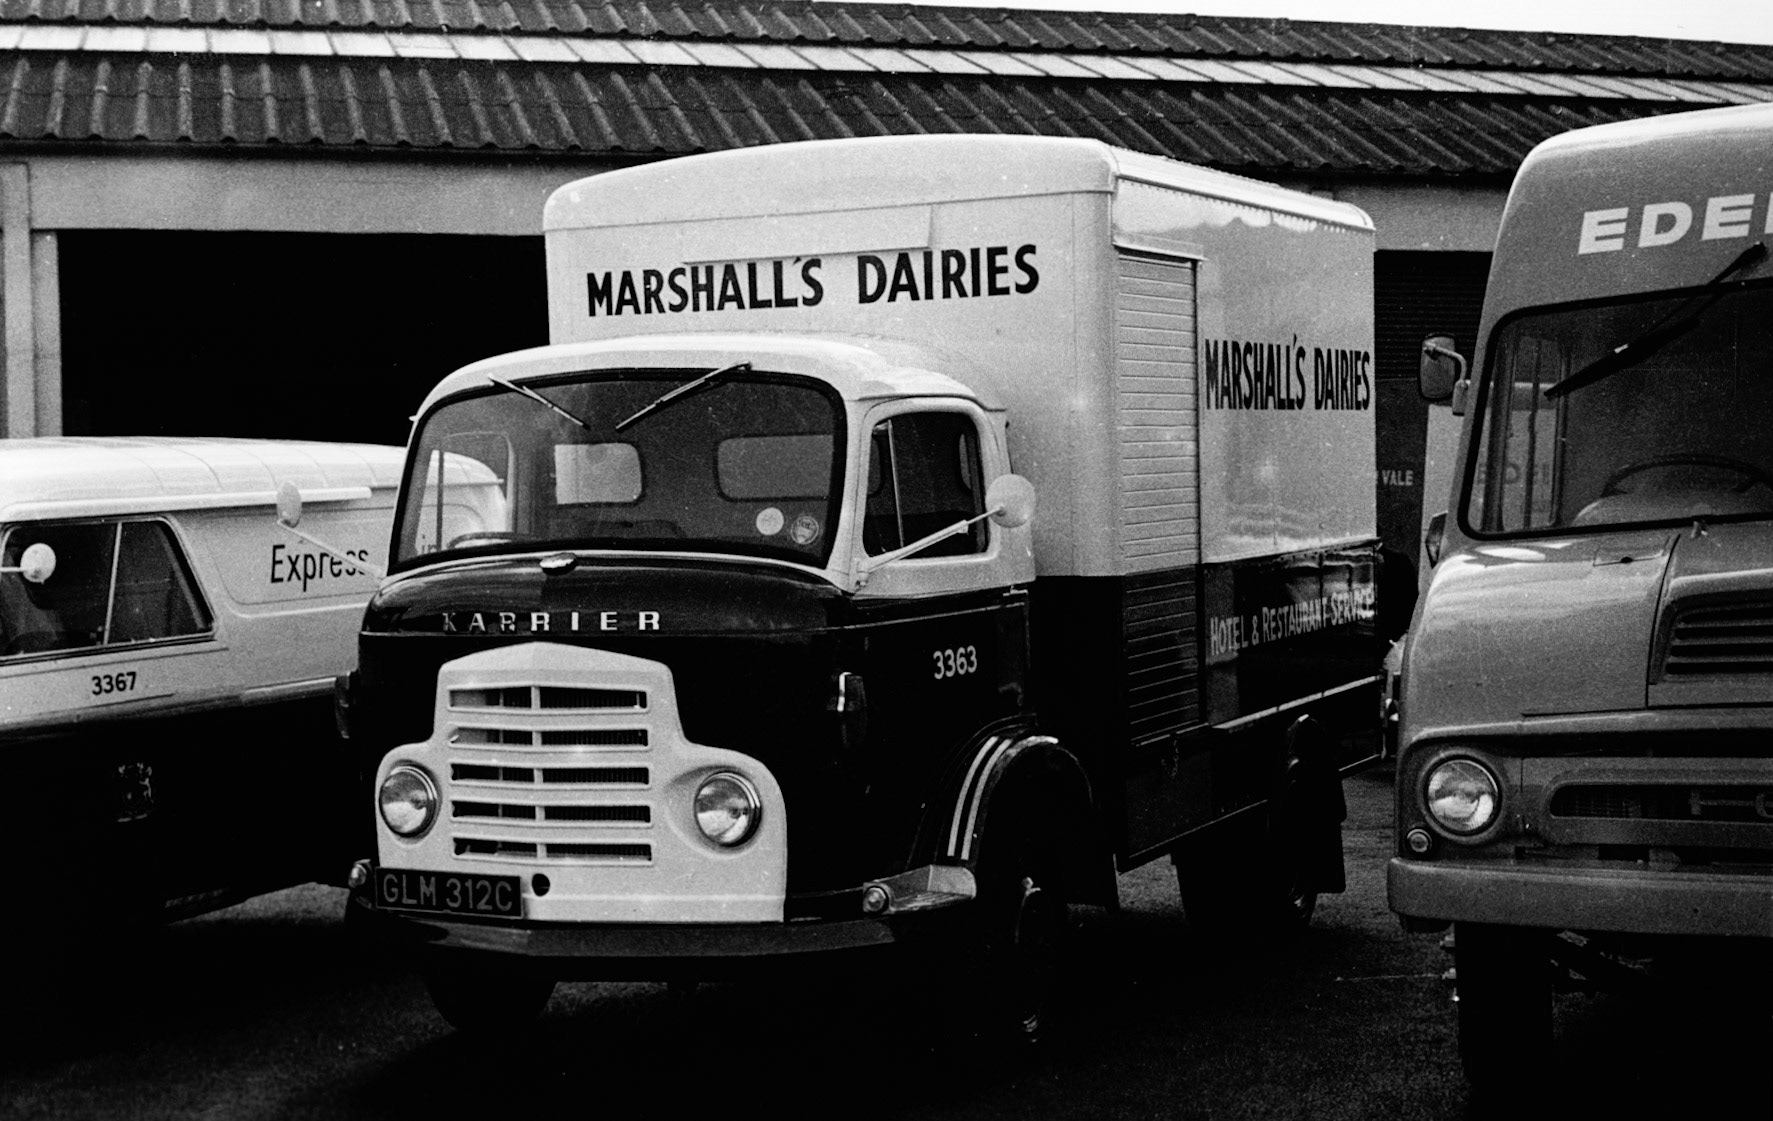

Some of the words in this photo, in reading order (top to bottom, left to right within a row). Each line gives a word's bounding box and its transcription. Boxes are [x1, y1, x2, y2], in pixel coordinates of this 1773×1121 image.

[1577, 192, 1773, 255] EDE
[586, 256, 824, 316] MARSHALL'S
[857, 244, 1040, 304] DAIRIES
[1205, 333, 1306, 410] MARSHALL'S
[1314, 347, 1371, 410] DAIRIES
[1381, 470, 1414, 486] VALE
[442, 611, 661, 631] KARRIER
[1210, 614, 1249, 657] HOTEL
[1252, 614, 1260, 646] &
[1262, 597, 1327, 643] RESTAURANT
[933, 645, 978, 679] 3363
[91, 672, 137, 696] 3367
[382, 873, 437, 906] GLM
[446, 879, 513, 911] 312C
